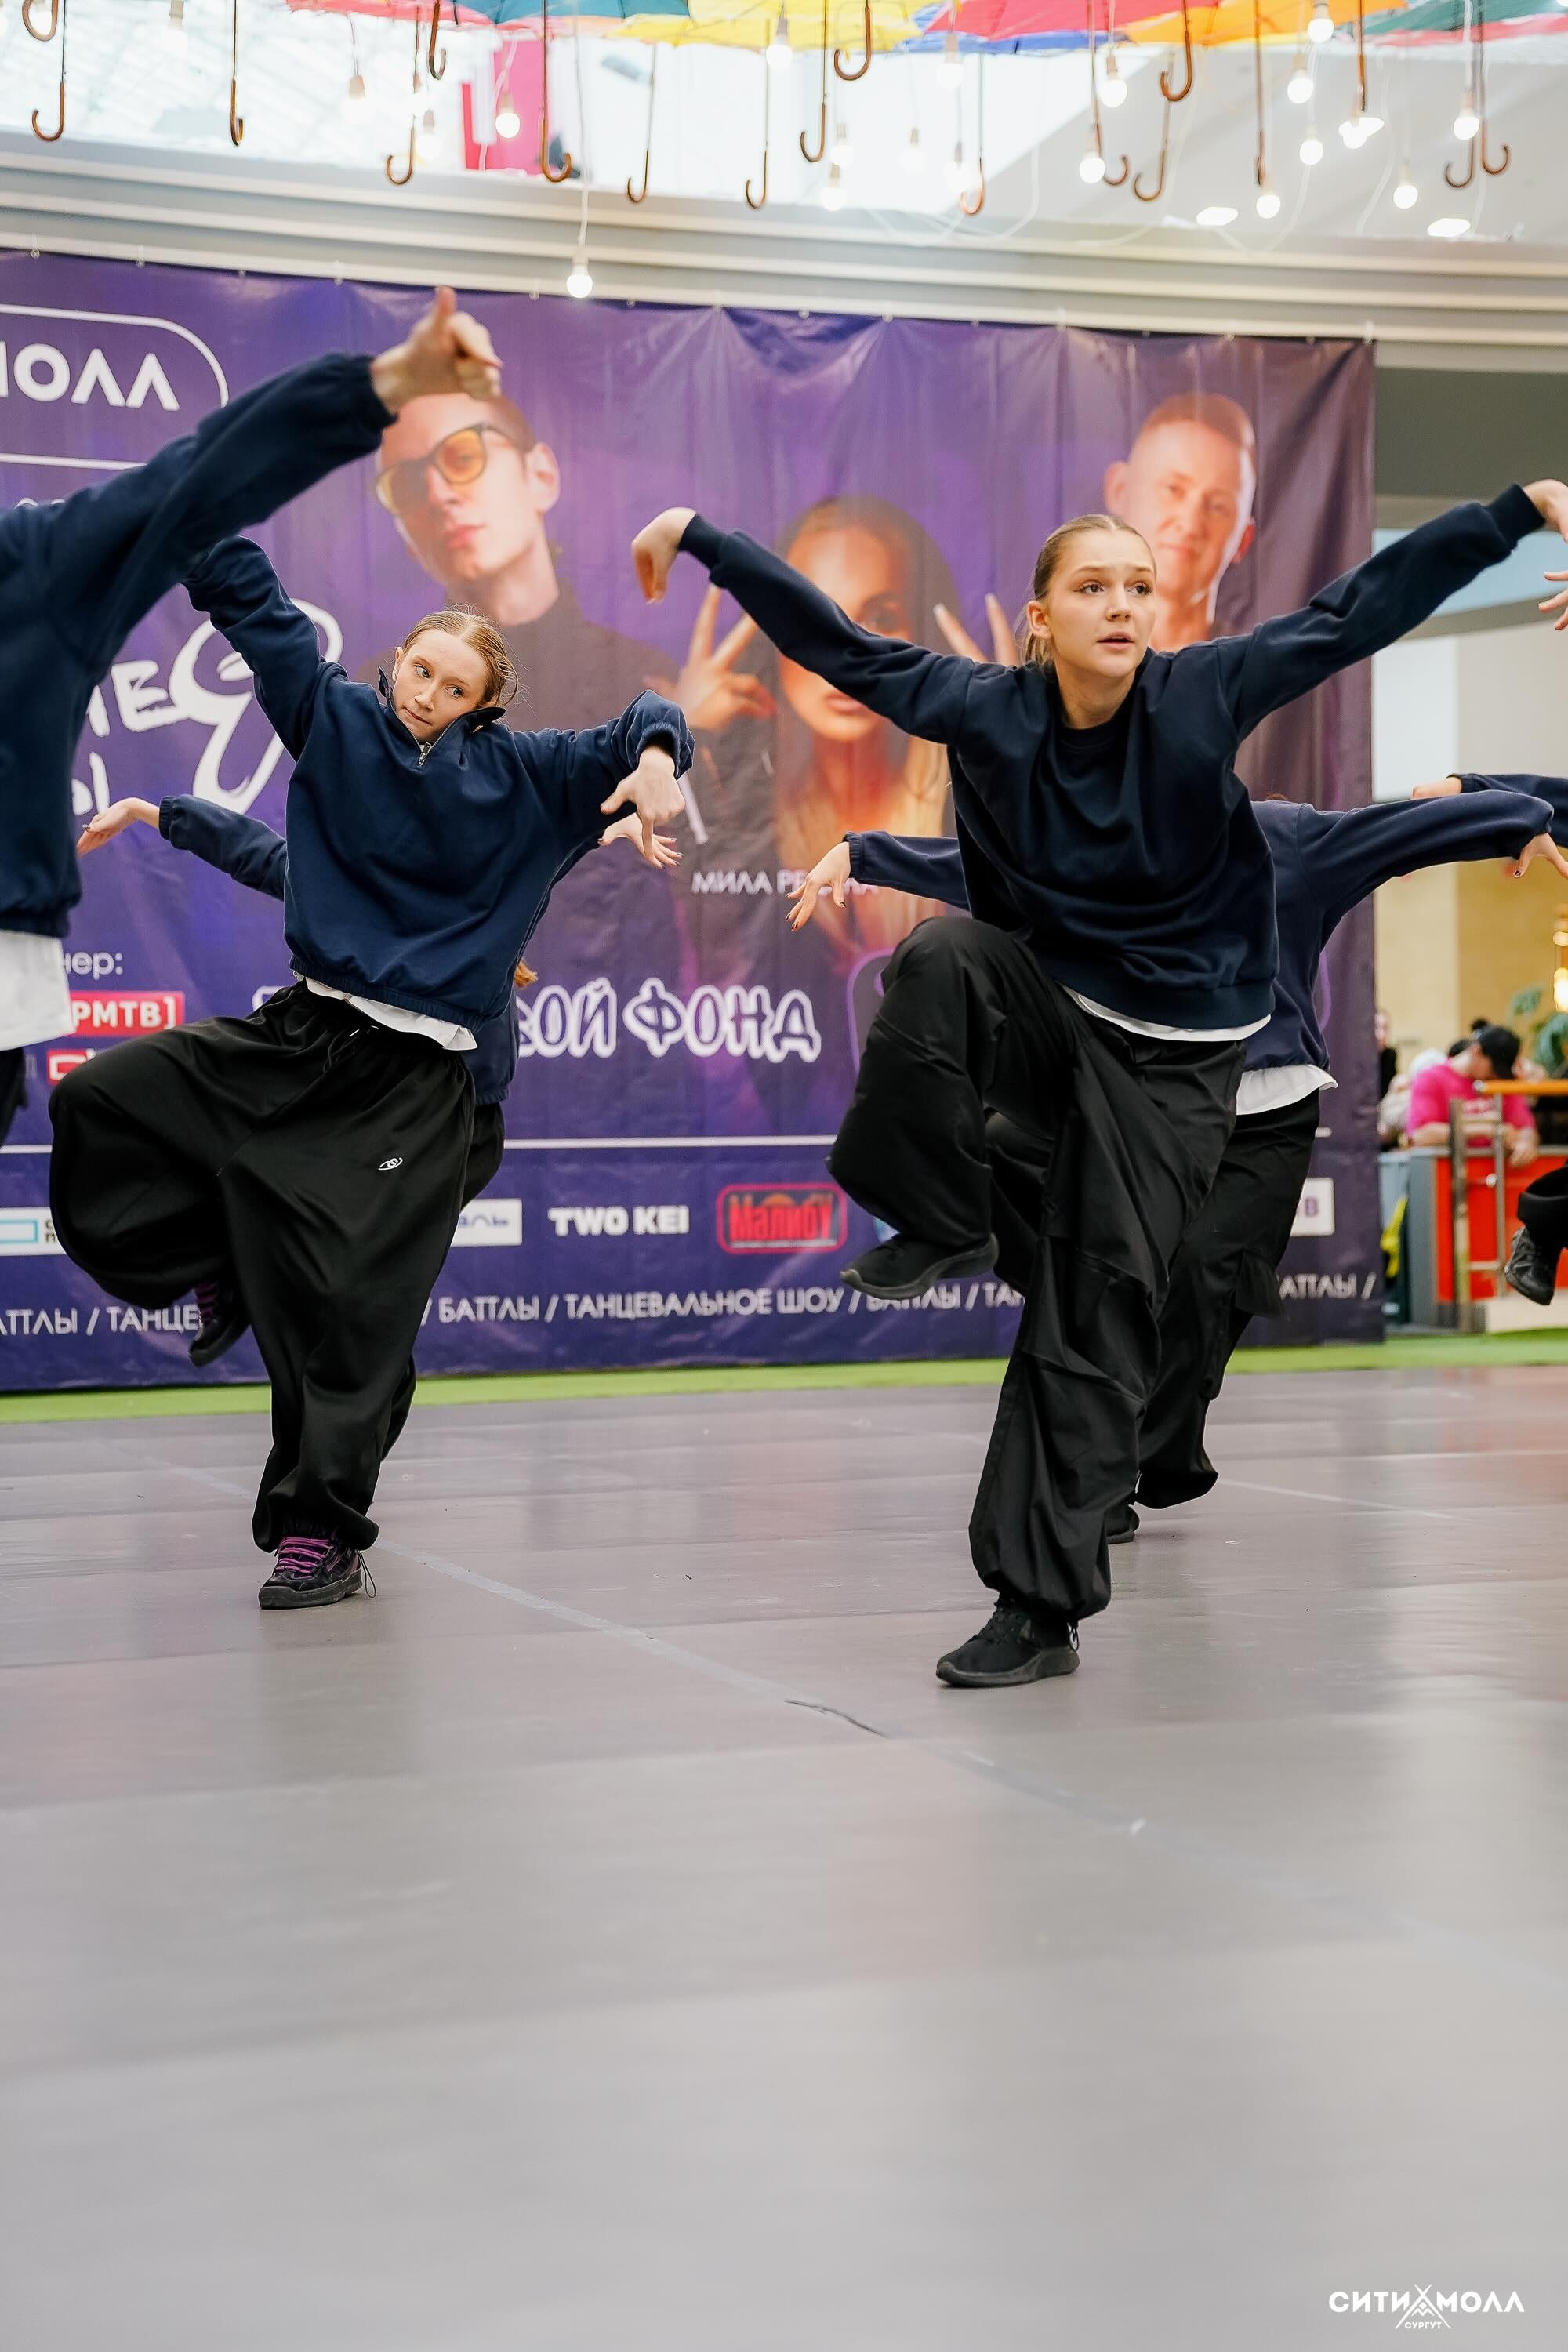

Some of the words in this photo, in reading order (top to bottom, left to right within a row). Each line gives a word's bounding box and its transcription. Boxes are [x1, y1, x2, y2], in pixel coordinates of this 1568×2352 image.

[0, 340, 180, 411] ОЛЛ
[691, 869, 774, 895] МИЛА
[622, 977, 822, 1064] ФОНД
[548, 1207, 628, 1236] TWO
[633, 1205, 690, 1235] KEI
[1279, 1273, 1357, 1300] АТТЛЫ
[563, 1288, 773, 1320] ТАНЦЕВАЛЬНОЕ
[776, 1286, 844, 1314] ШОУ
